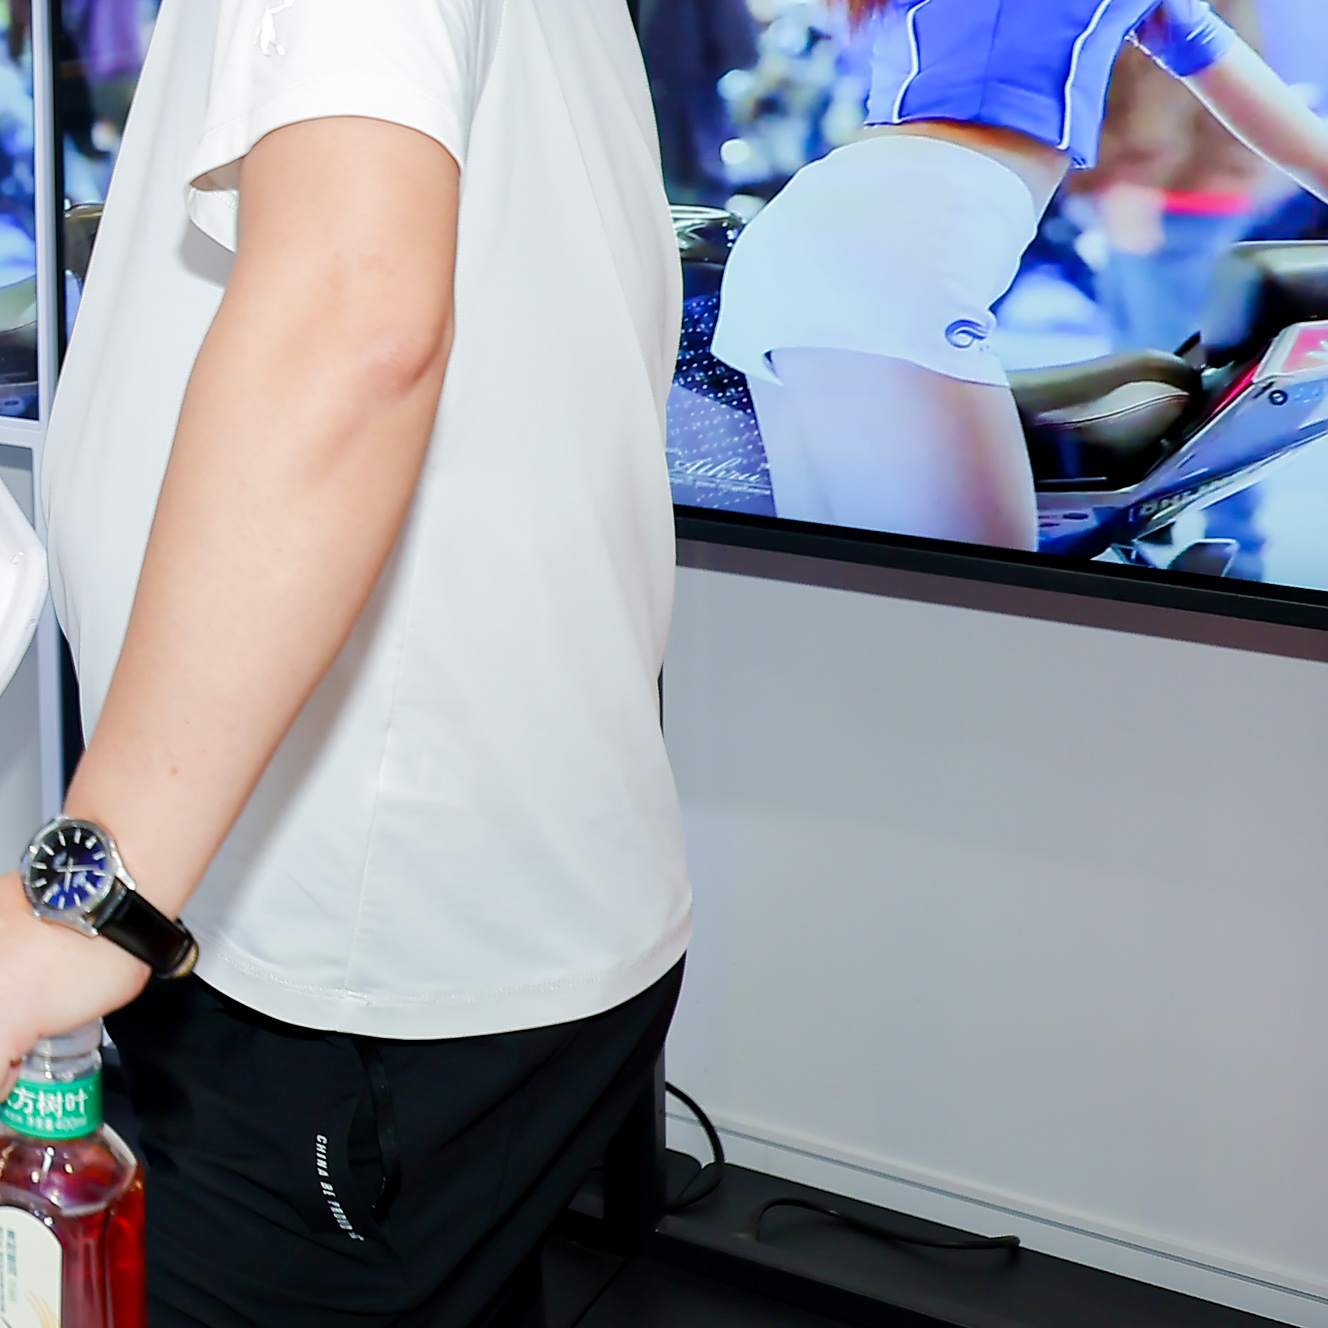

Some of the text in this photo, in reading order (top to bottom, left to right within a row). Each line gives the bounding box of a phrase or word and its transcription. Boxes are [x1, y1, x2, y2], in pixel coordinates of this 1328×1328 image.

[7, 1087, 88, 1120] 方树叶
[316, 1134, 329, 1177] CHINA
